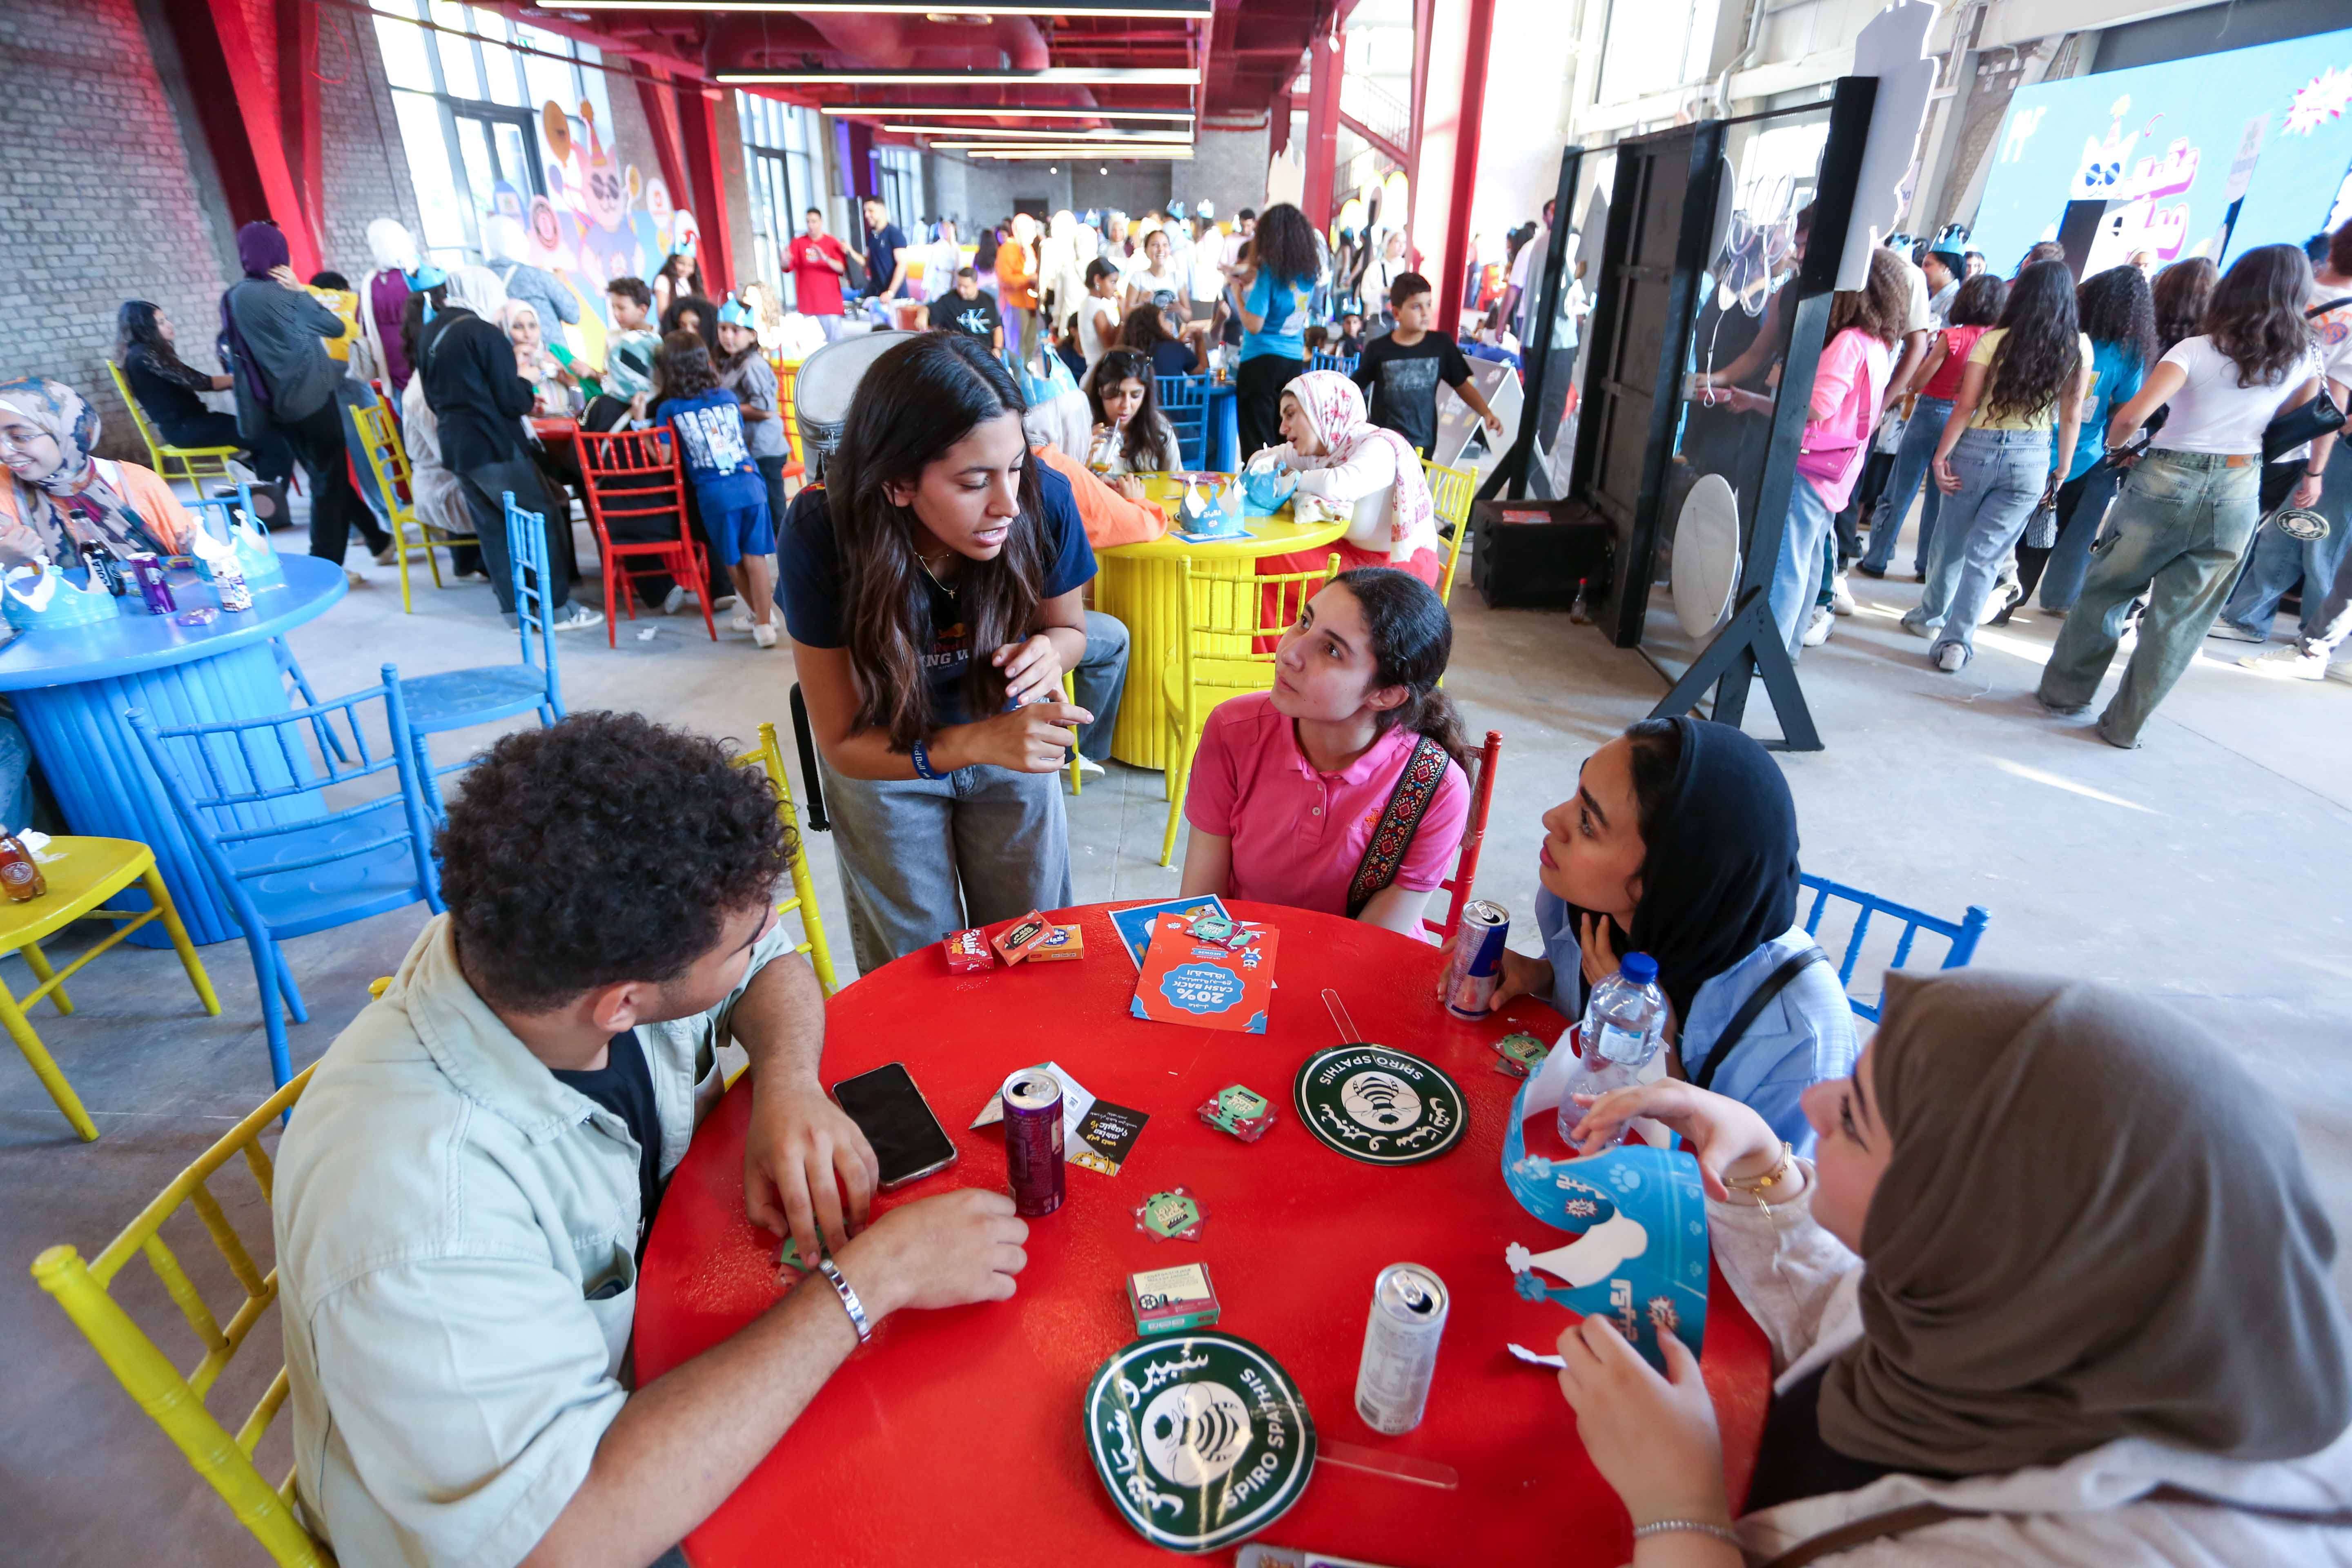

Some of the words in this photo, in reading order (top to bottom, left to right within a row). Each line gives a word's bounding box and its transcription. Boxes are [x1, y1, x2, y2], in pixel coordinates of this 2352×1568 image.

[915, 756, 927, 769] Bull
[1172, 980, 1203, 990] BACK
[1205, 983, 1233, 993] CASH
[1176, 987, 1224, 1004] 20%
[1319, 1055, 1371, 1085] SPATHIS
[1374, 1057, 1424, 1080] SPIRO
[1239, 1368, 1286, 1450] SPATHIS
[1223, 1452, 1279, 1509] SPIRO
